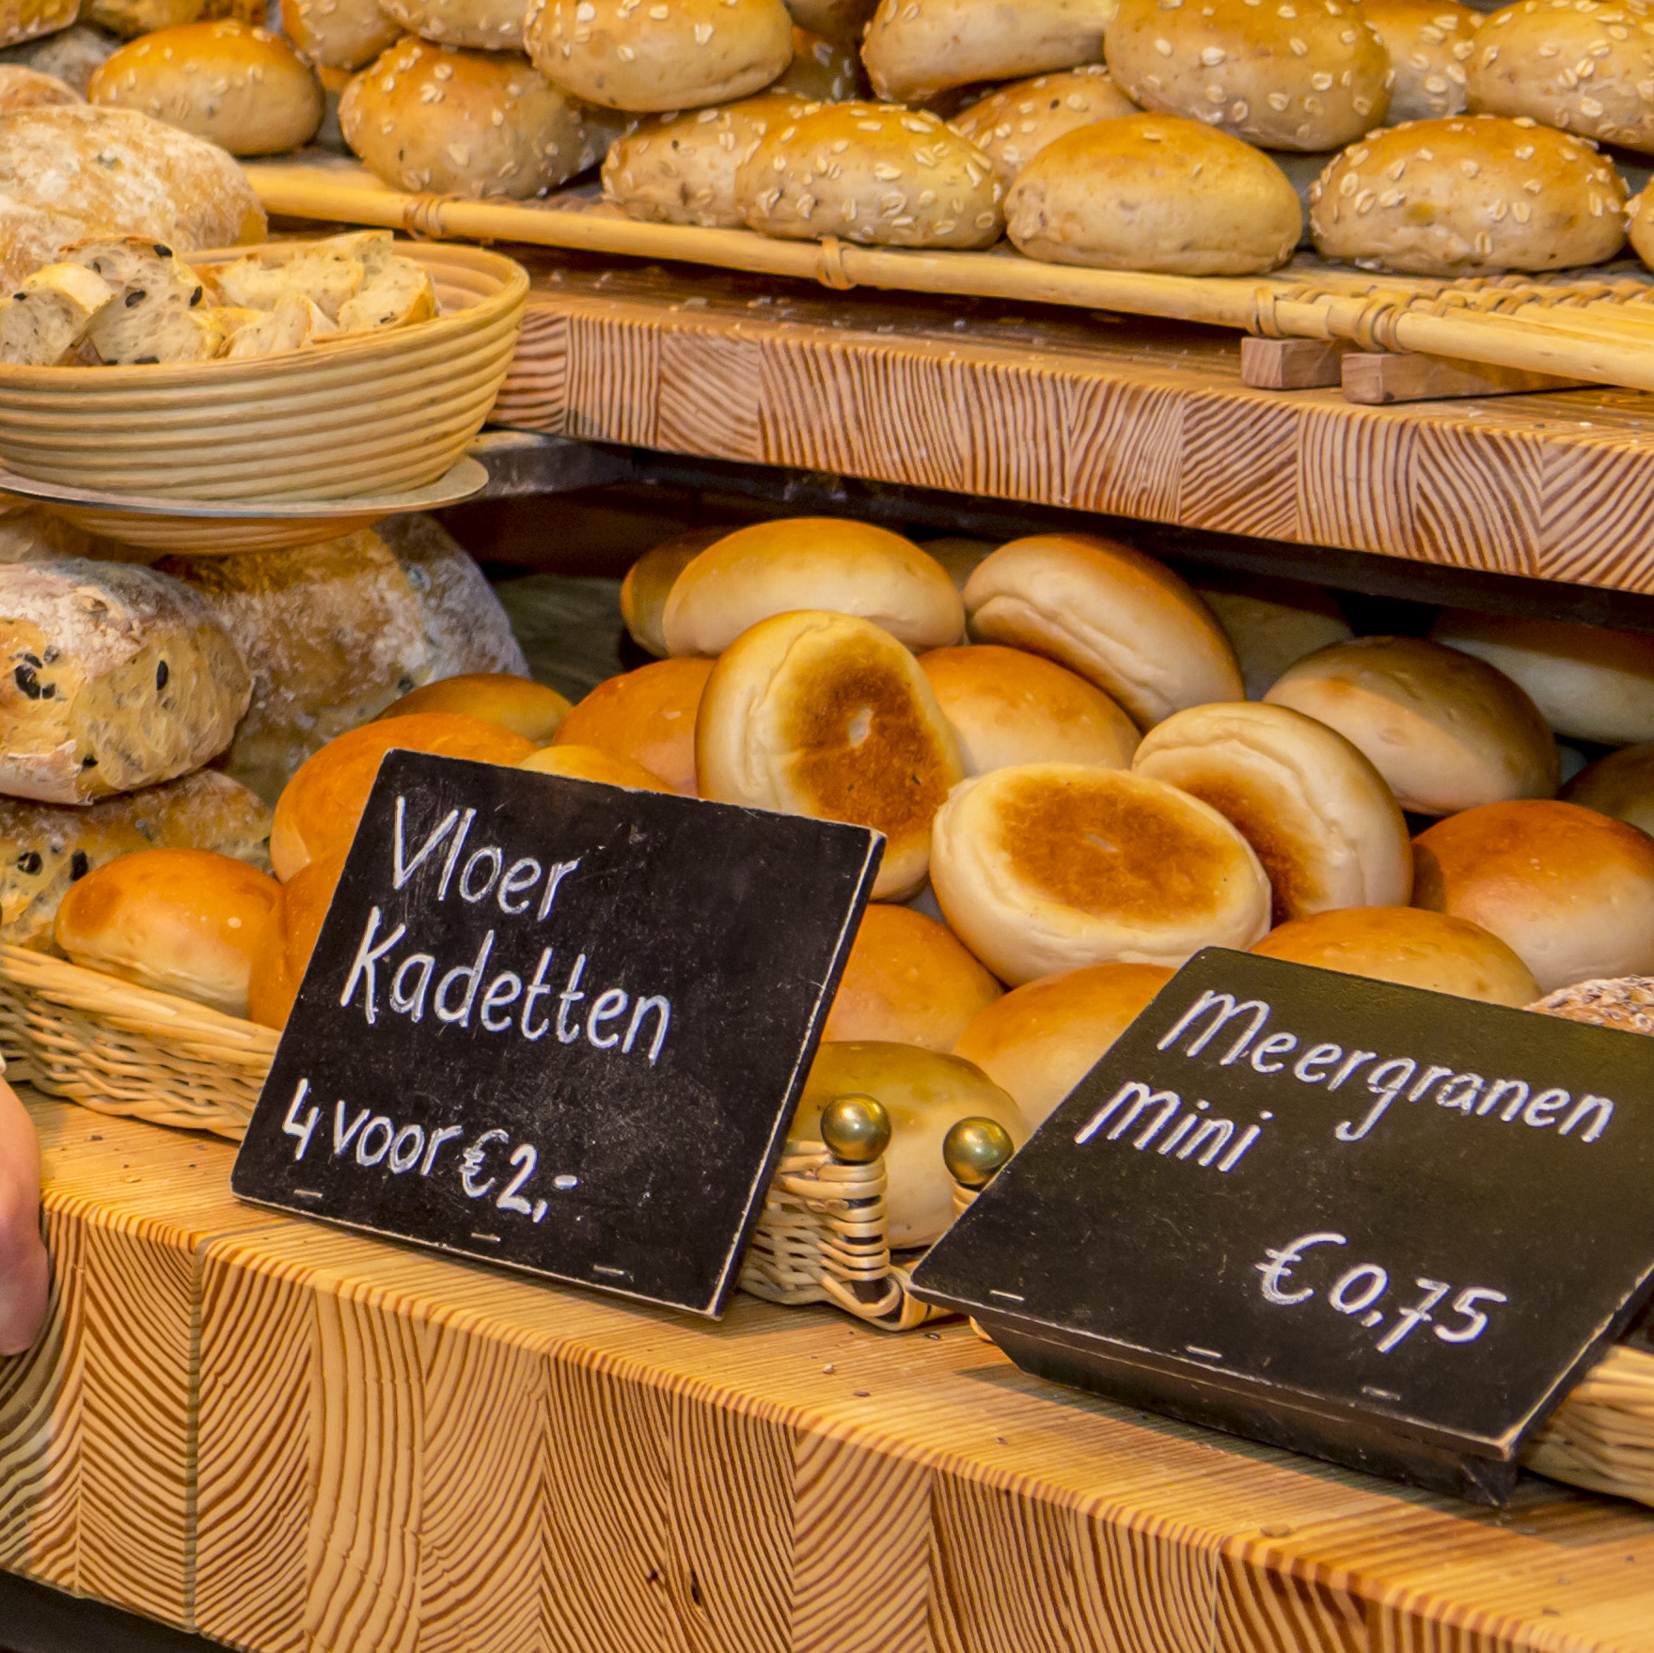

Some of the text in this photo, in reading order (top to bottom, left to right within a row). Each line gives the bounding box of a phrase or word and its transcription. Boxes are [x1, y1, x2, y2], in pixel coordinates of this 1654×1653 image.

[392, 795, 580, 921] Vloer
[340, 906, 673, 1066] Kadetten
[1156, 988, 1615, 1143] Meergranen
